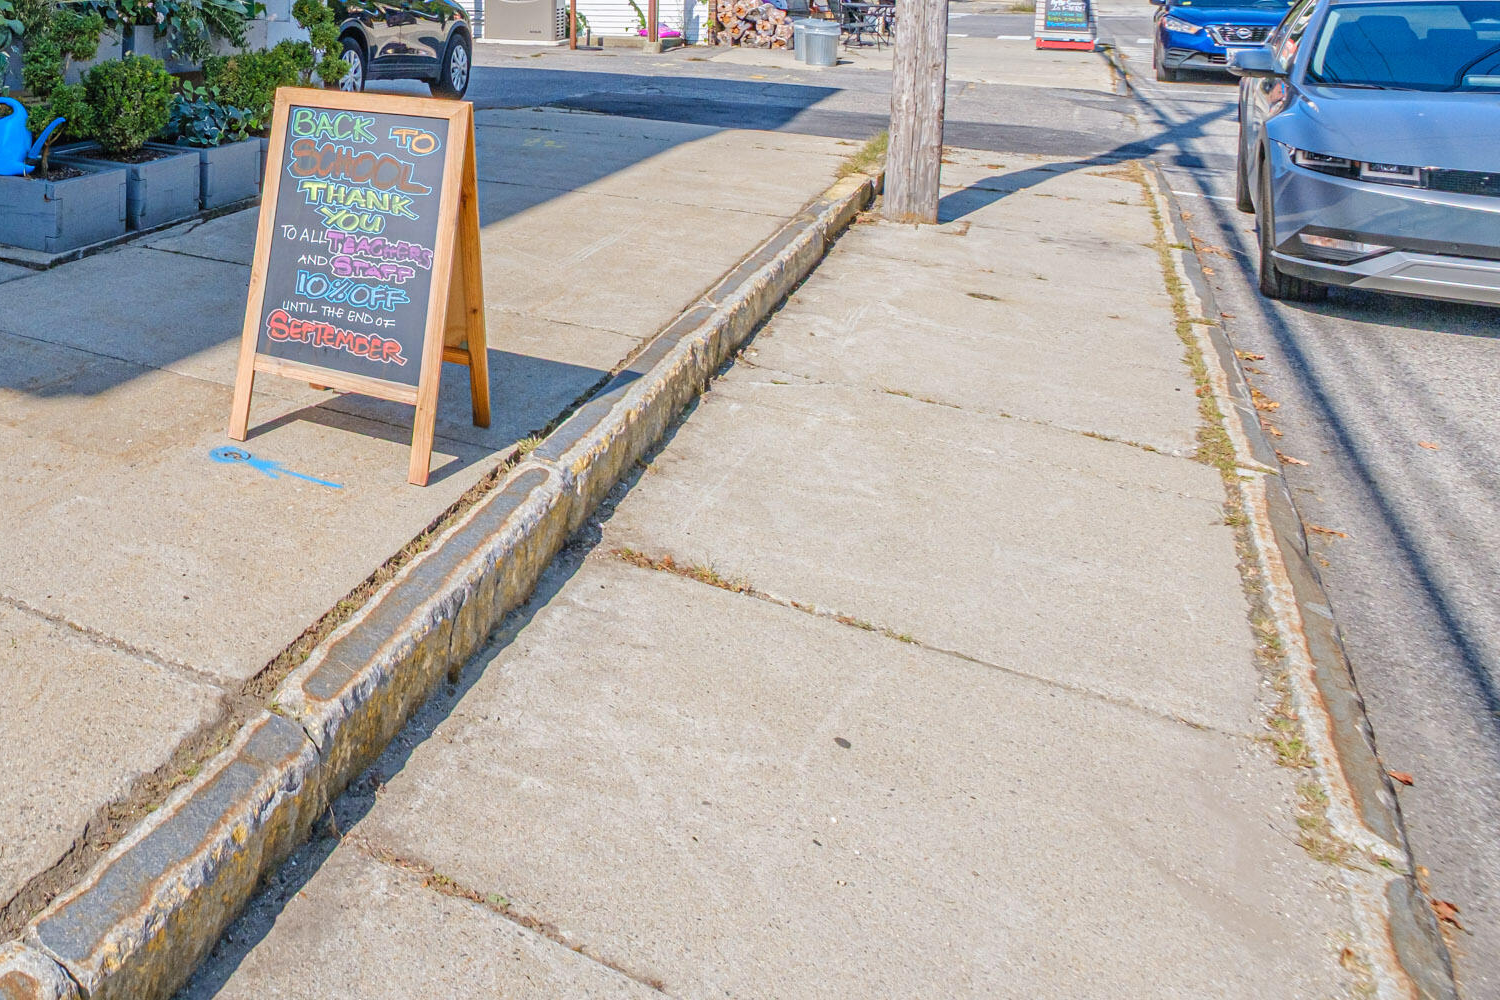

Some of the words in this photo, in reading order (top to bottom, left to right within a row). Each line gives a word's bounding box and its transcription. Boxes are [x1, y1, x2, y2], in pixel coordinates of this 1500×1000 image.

[291, 108, 376, 143] BACK
[389, 127, 441, 156] TO
[288, 139, 432, 195] SCHOOL
[298, 181, 419, 220] THANK
[316, 206, 386, 234] YOU
[281, 224, 297, 240] TO
[300, 227, 327, 244] ALL
[326, 230, 434, 269] TEACHERS
[297, 254, 328, 267] AND
[329, 255, 415, 282] STAFF
[282, 300, 318, 315] UNTIL
[321, 305, 344, 318] THE
[347, 310, 373, 325] END
[375, 318, 396, 328] OF
[267, 308, 407, 365] SEPTEMBER
